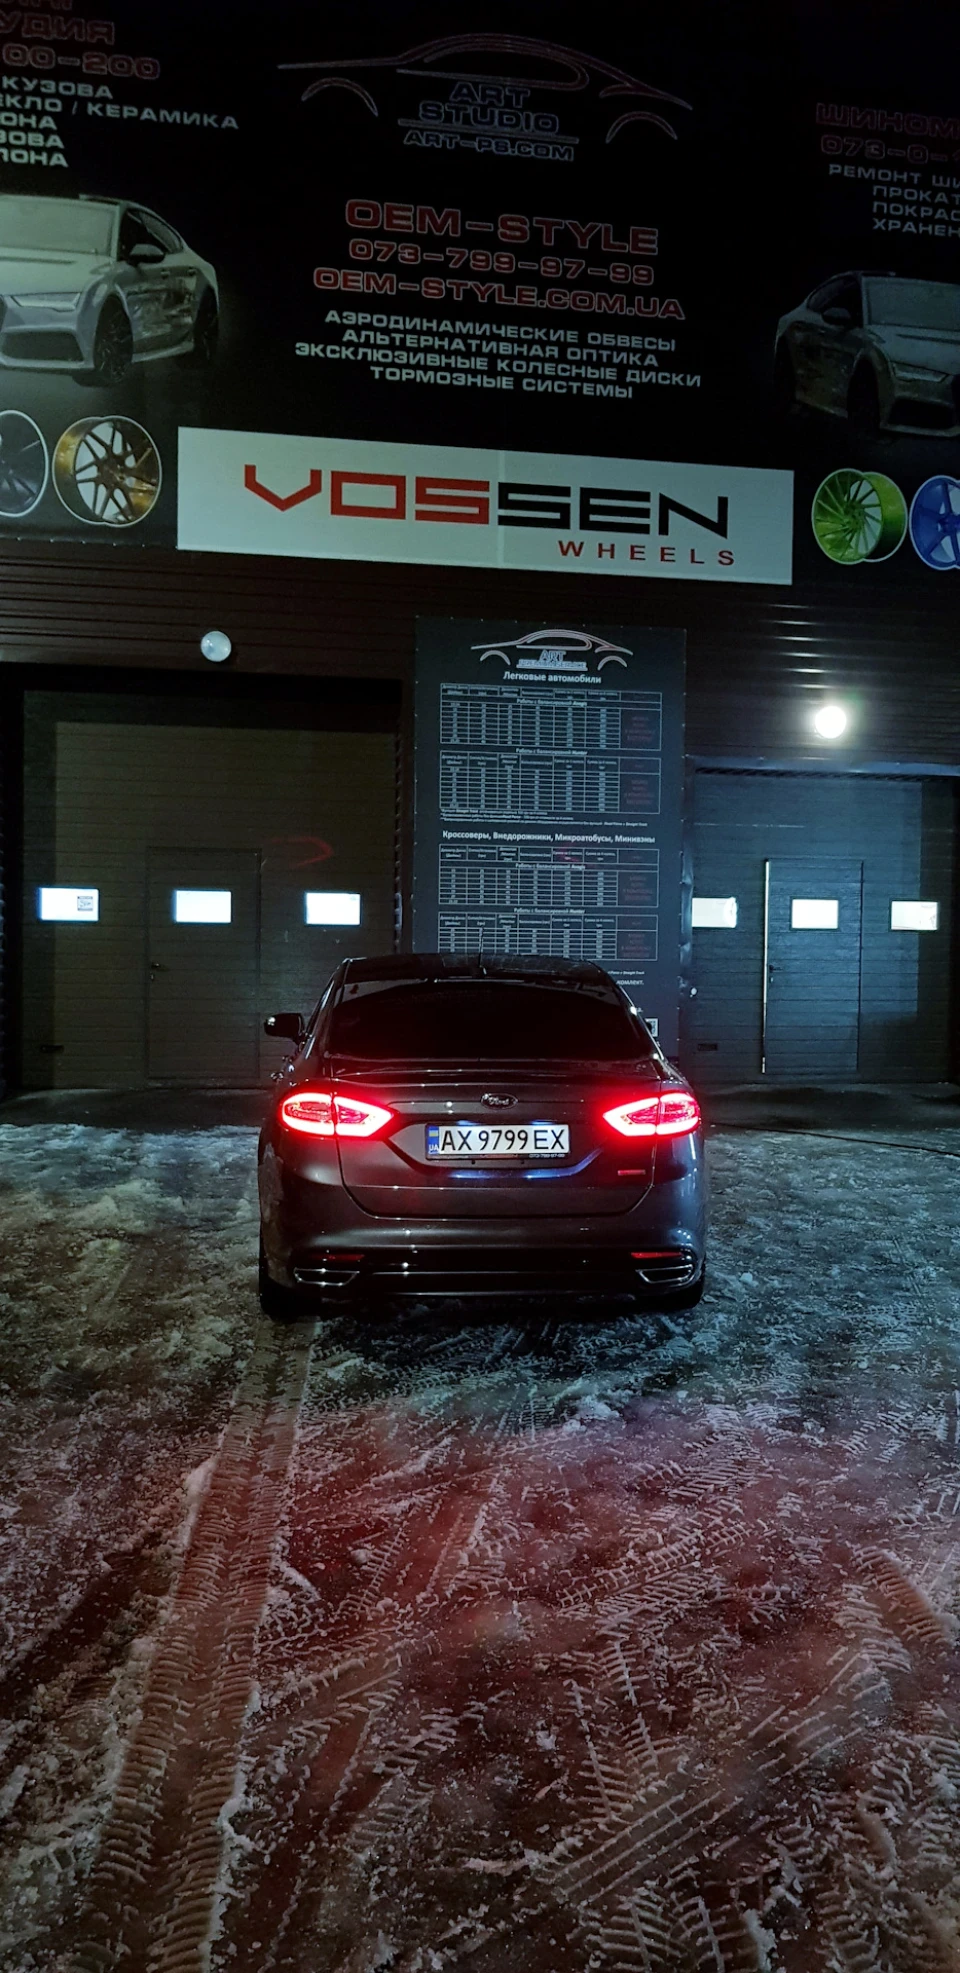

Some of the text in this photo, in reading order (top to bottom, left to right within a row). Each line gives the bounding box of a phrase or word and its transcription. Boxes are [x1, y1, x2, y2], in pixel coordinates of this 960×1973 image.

[1, 74, 113, 99] КУЗОВА
[449, 80, 530, 109] ART
[0, 92, 63, 112] КЛО
[86, 101, 240, 130] КЕРАМИКА
[418, 100, 560, 136] STUDIO
[828, 163, 922, 185] РЕМОНТ
[872, 184, 960, 206] ПРОКАТ
[872, 200, 960, 222] ПОКРАС
[345, 199, 660, 256] OEM-STYLE
[348, 237, 656, 287] 073-799-97-99
[313, 266, 687, 321] OEM-STYLE.COM.UA
[324, 309, 677, 352] АЭРОДИНАМИЧЕСКИЕ ОБВЕСЫ
[342, 329, 660, 368] АЛЬТЕРНАТИВНАЯ ОПТИКА
[295, 341, 702, 388] ЭКСКЛЮЗИВНЫЕ КОЛЕСНЫЕ ДИСКИ
[370, 366, 634, 400] ТОРМОЗНЫЕ СИСТЕМЫ
[244, 464, 729, 540] VOSSEN
[557, 540, 735, 567] WHEELS
[538, 649, 567, 662] ART
[503, 671, 602, 684] Легковые автомобили
[442, 830, 492, 841] Кроссоверы,
[441, 1130, 472, 1151] AX
[478, 1129, 528, 1150] 9799
[534, 1129, 565, 1150] EX
